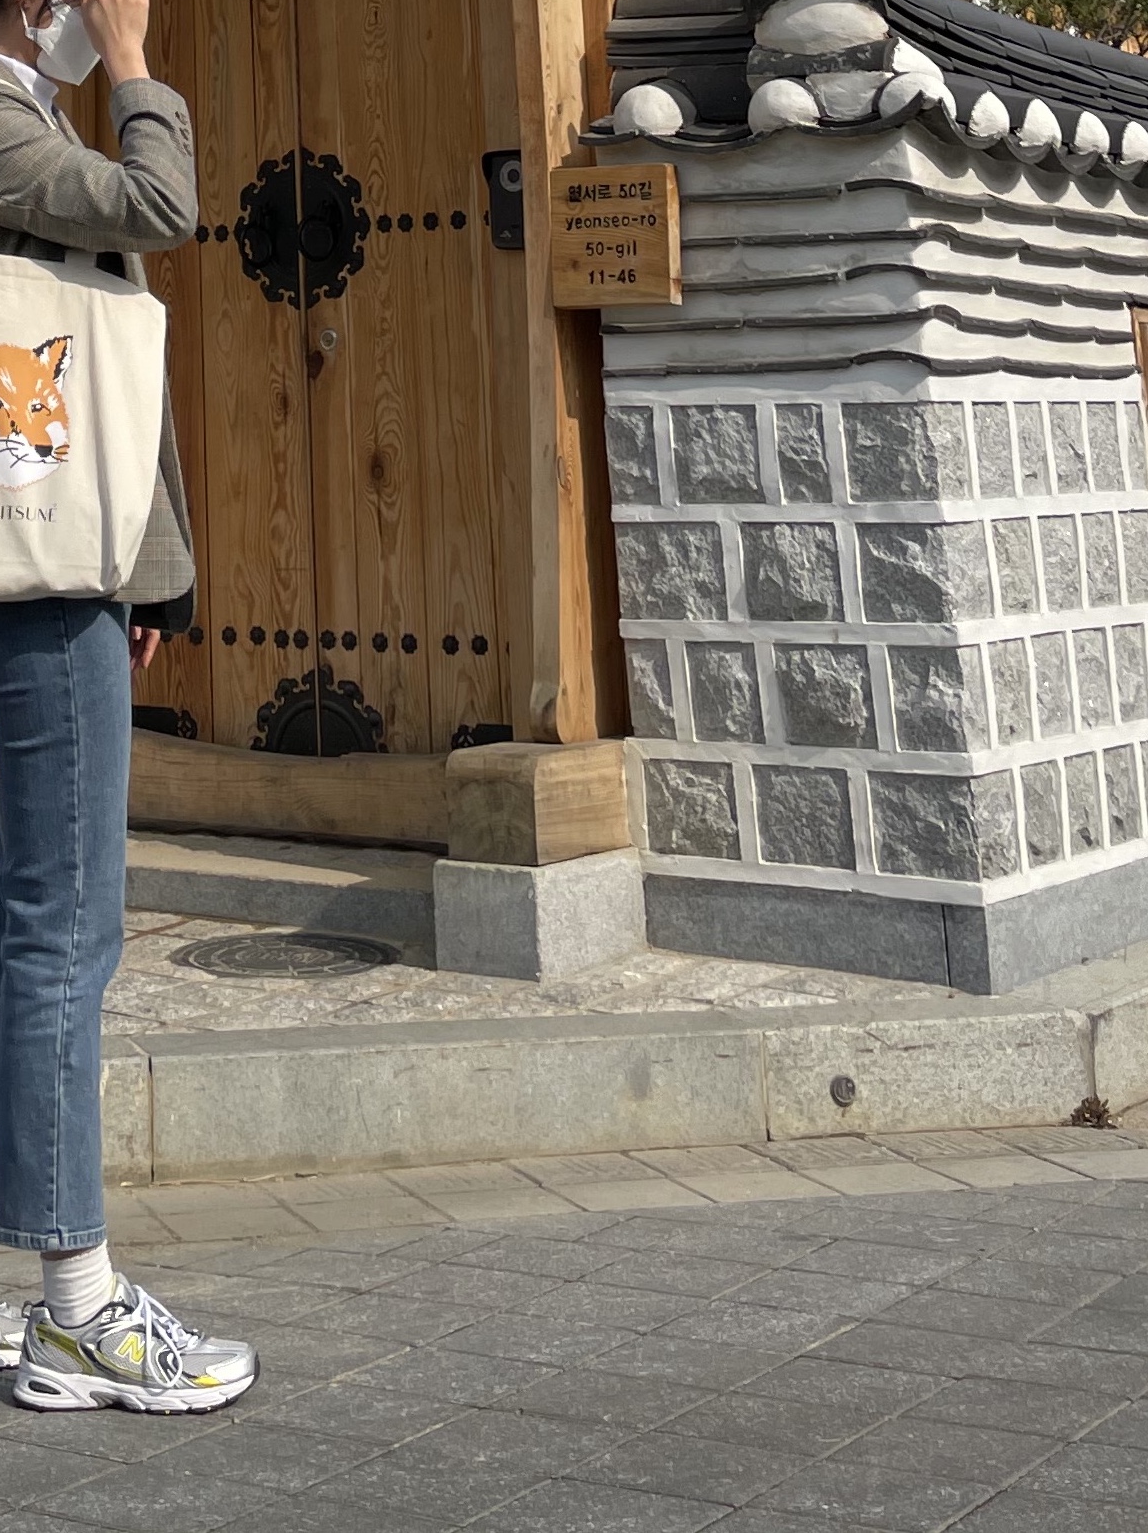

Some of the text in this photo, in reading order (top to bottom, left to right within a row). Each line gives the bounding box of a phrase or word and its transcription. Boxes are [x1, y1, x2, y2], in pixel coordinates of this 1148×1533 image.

[619, 180, 652, 201] 50길
[565, 214, 657, 231] yeonseo-ro
[585, 239, 637, 258] 50-gil
[588, 269, 636, 284] 11-46
